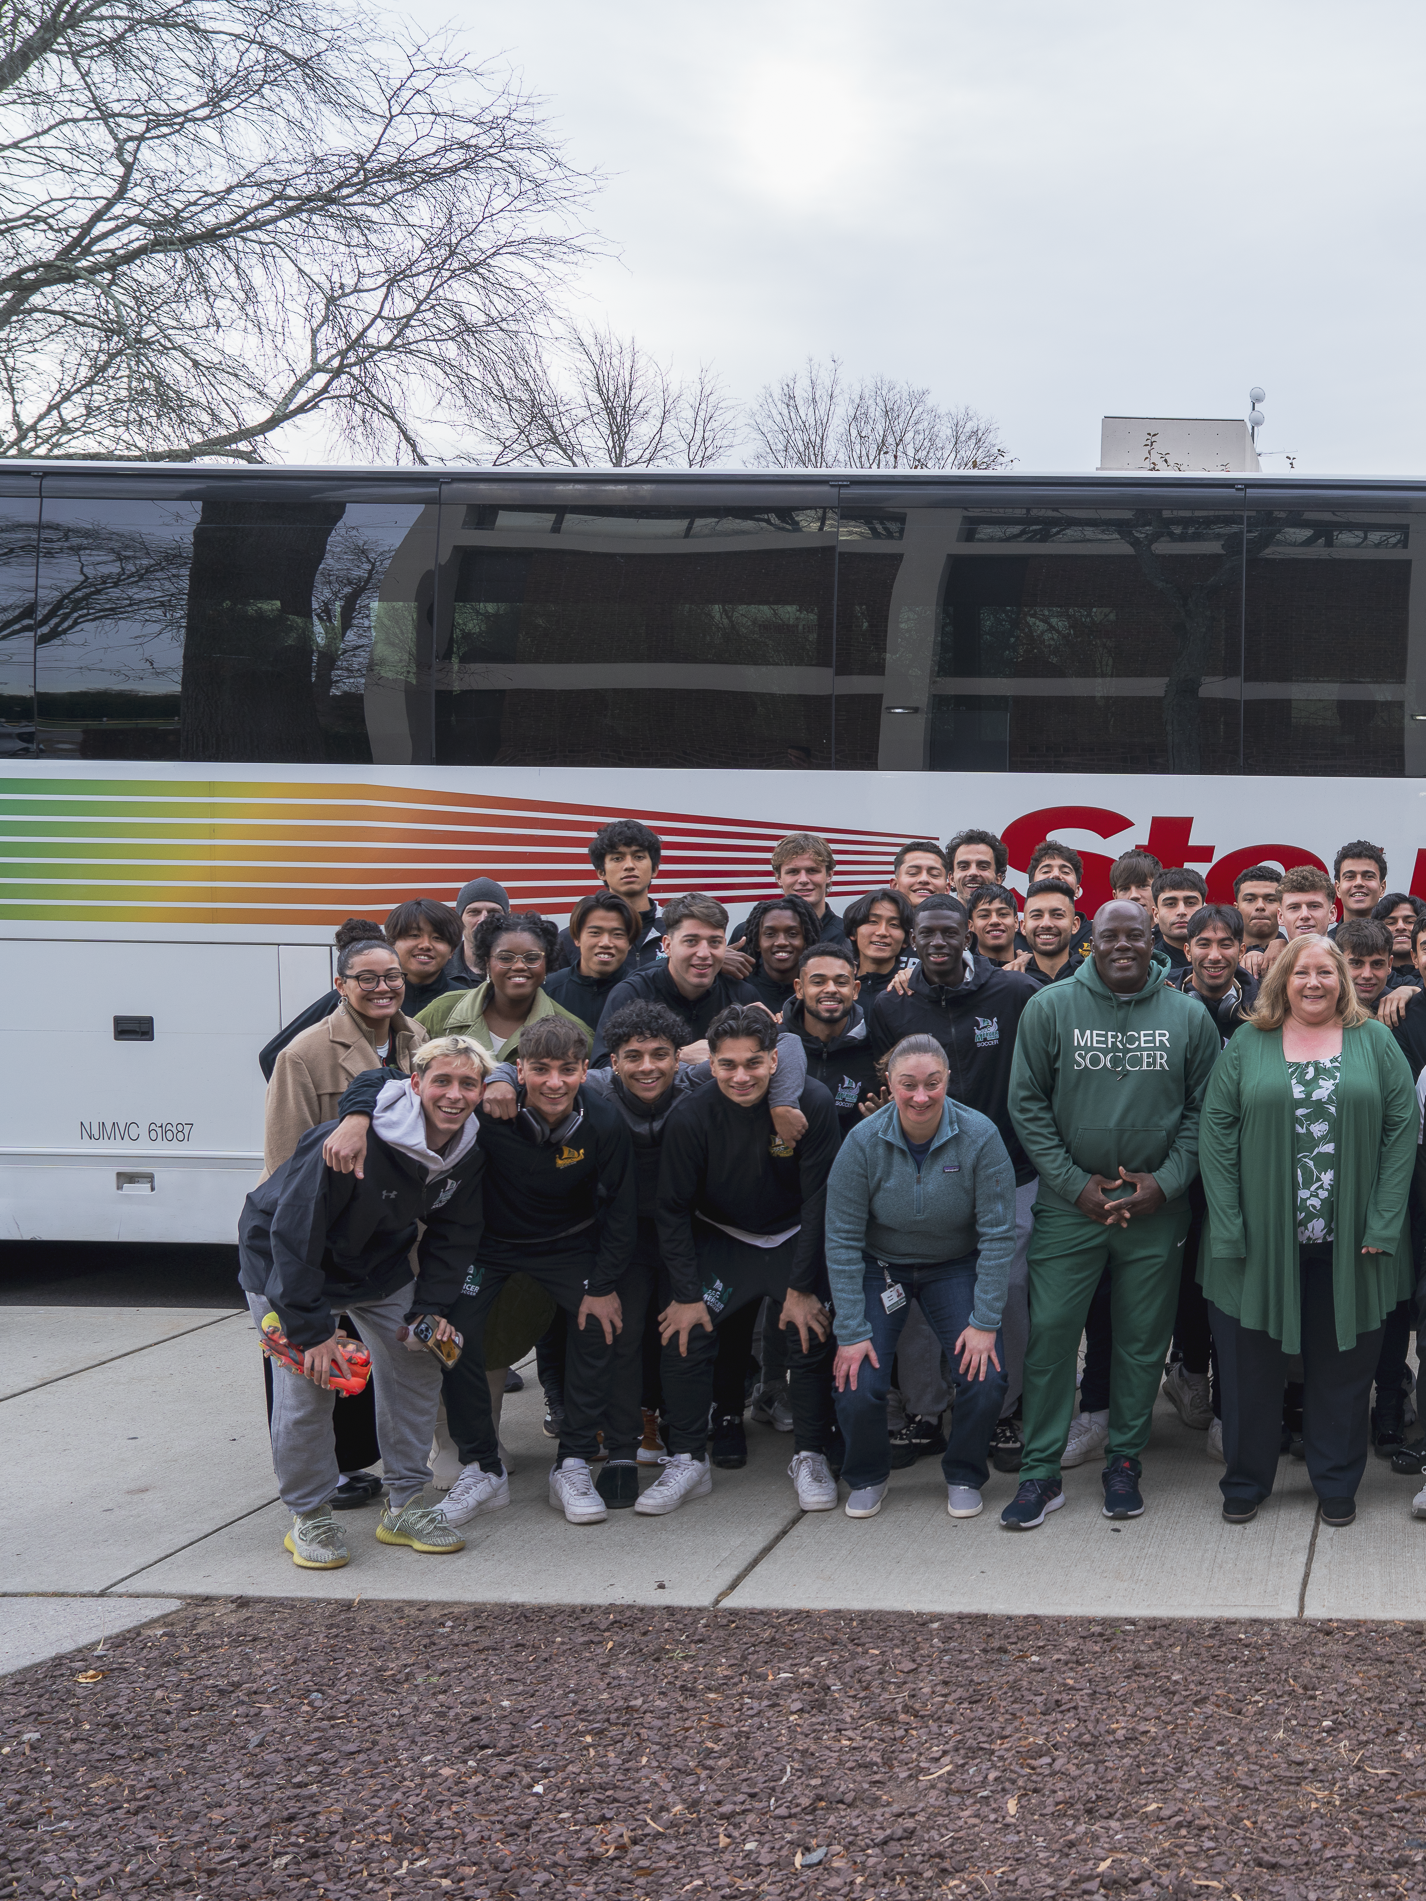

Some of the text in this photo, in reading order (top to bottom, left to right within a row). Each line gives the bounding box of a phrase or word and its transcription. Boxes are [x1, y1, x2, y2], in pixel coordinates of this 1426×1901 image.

[1073, 1029, 1170, 1049] MERCER
[1073, 1051, 1170, 1071] SOCCER
[80, 1121, 194, 1142] NJMVC 61687
